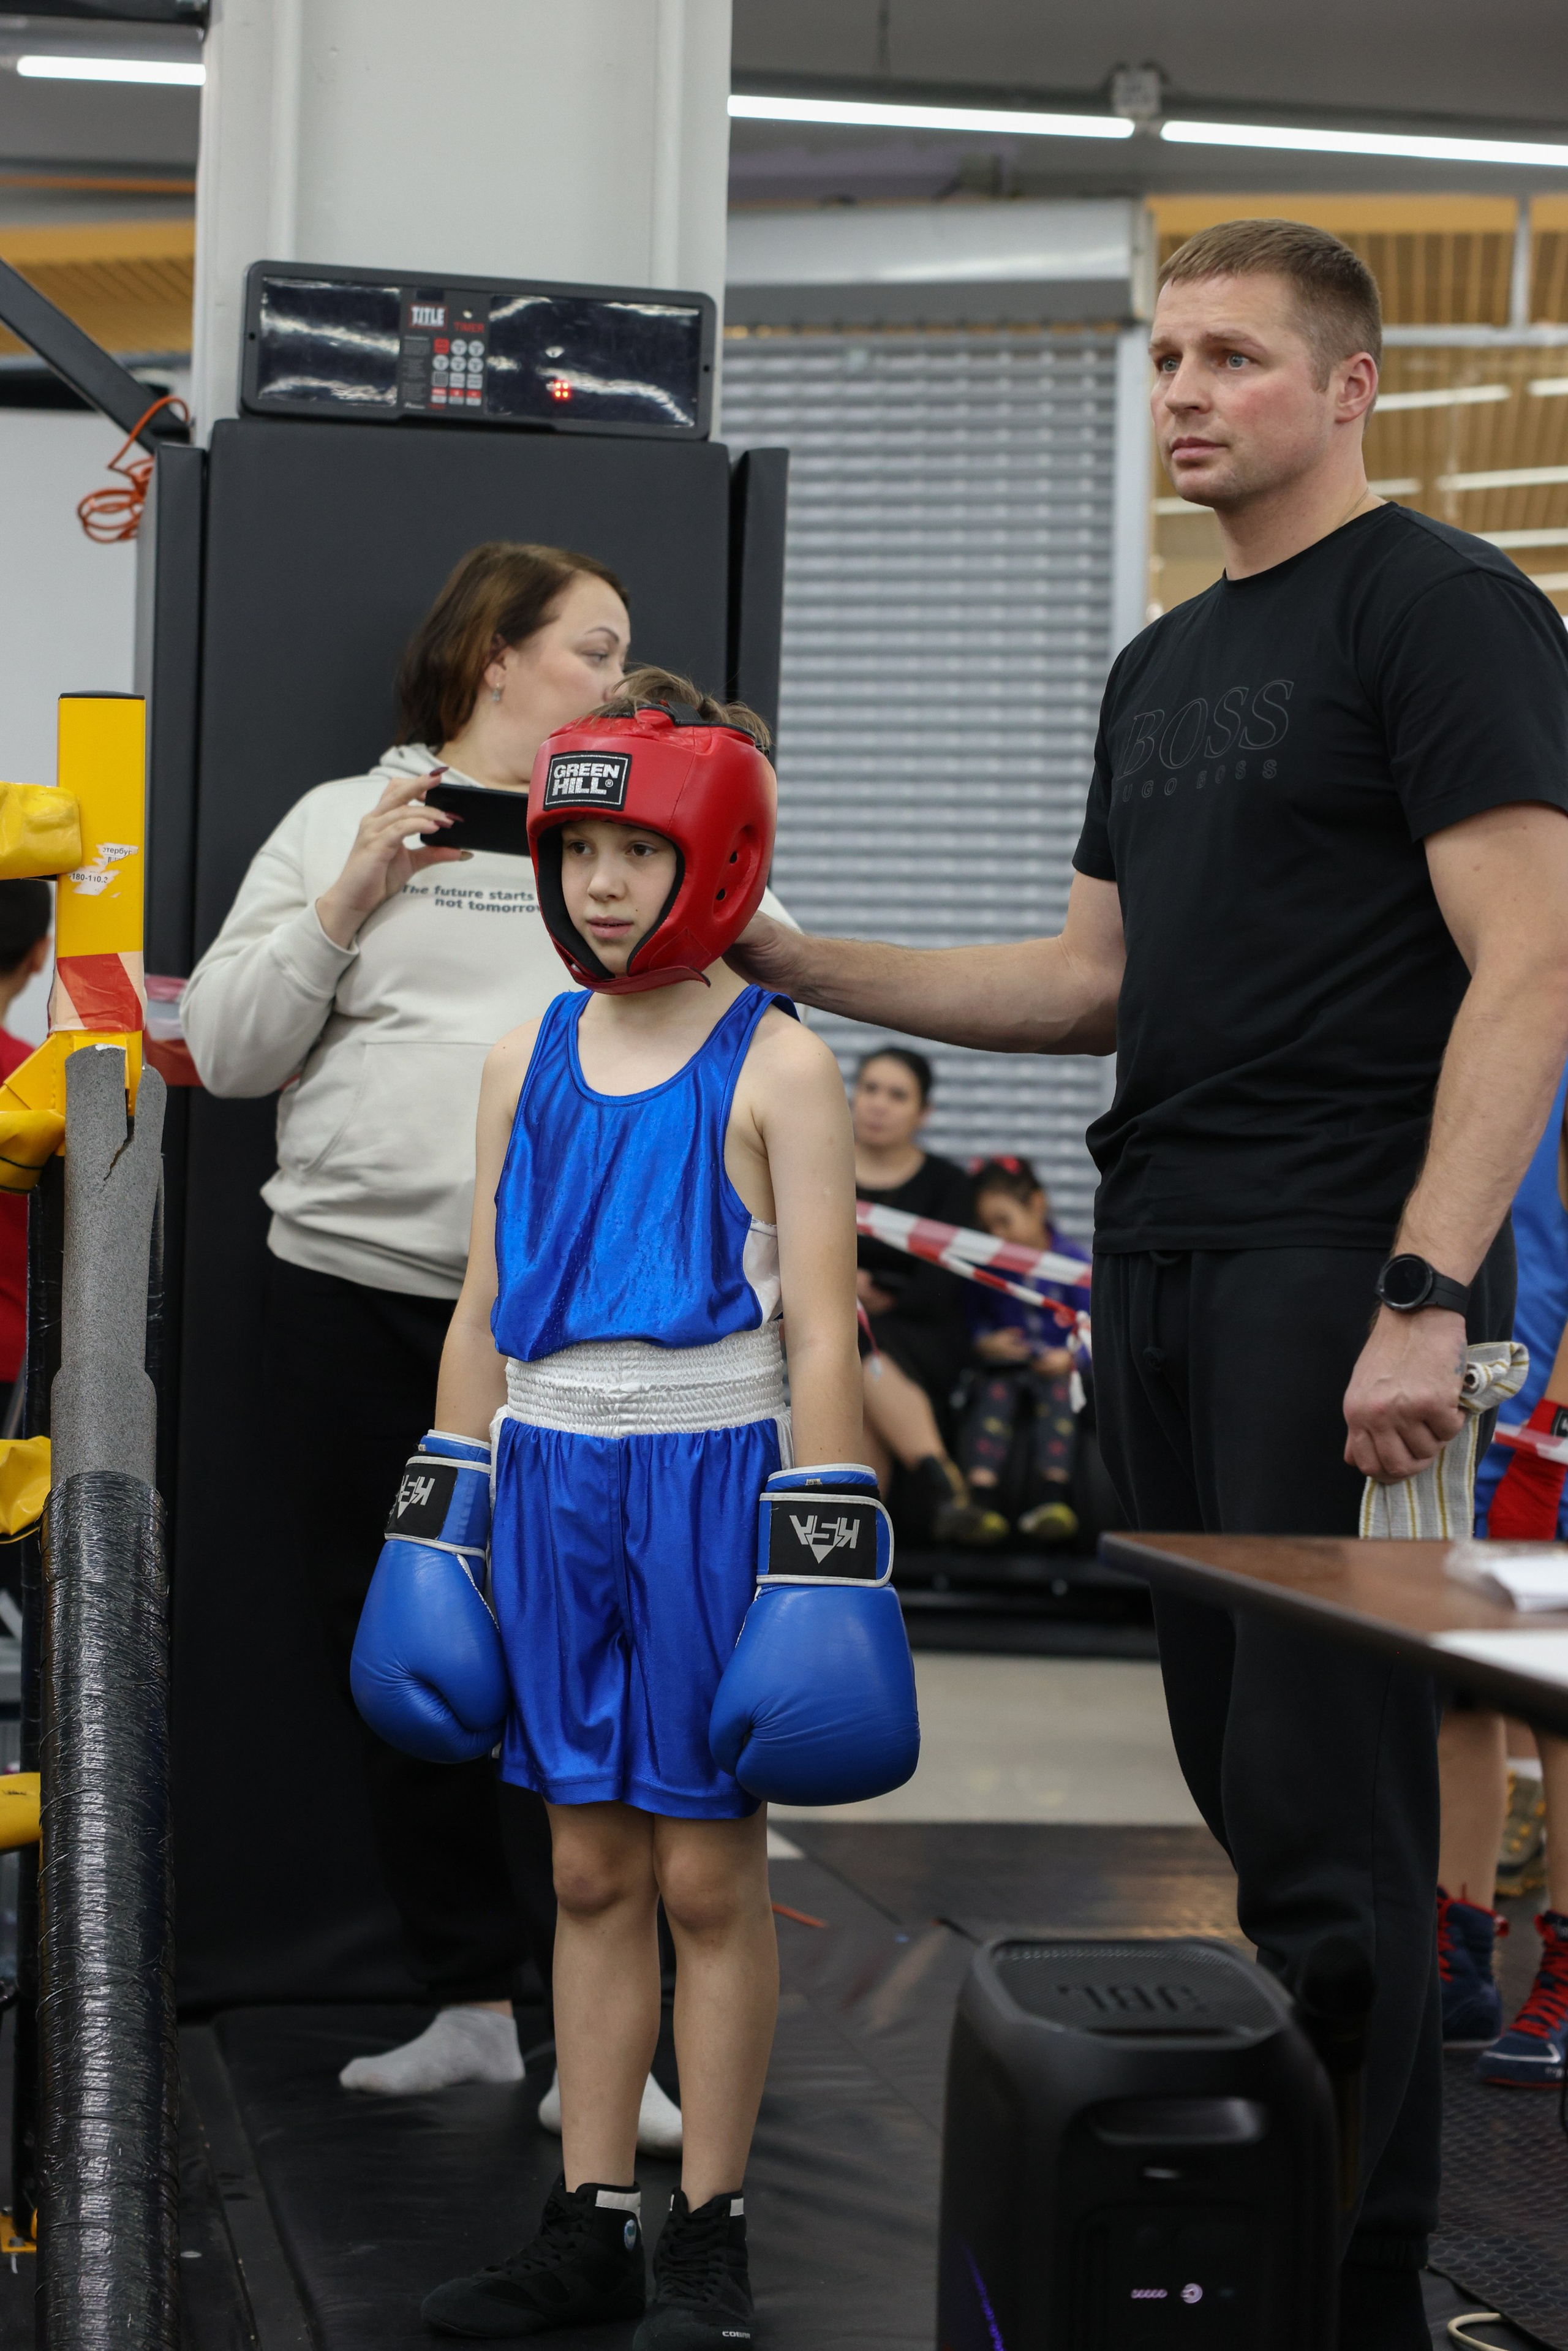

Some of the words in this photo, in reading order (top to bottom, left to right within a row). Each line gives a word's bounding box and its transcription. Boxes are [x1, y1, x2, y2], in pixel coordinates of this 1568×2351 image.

[411, 306, 445, 327] TITLE
[1117, 679, 1294, 781] BOSS
[554, 763, 620, 779] GREEN
[1196, 759, 1278, 790] BOSS
[552, 777, 607, 796] HILL
[402, 885, 429, 894] The
[434, 885, 484, 899] future
[489, 890, 534, 901] starts
[435, 898, 464, 909] not
